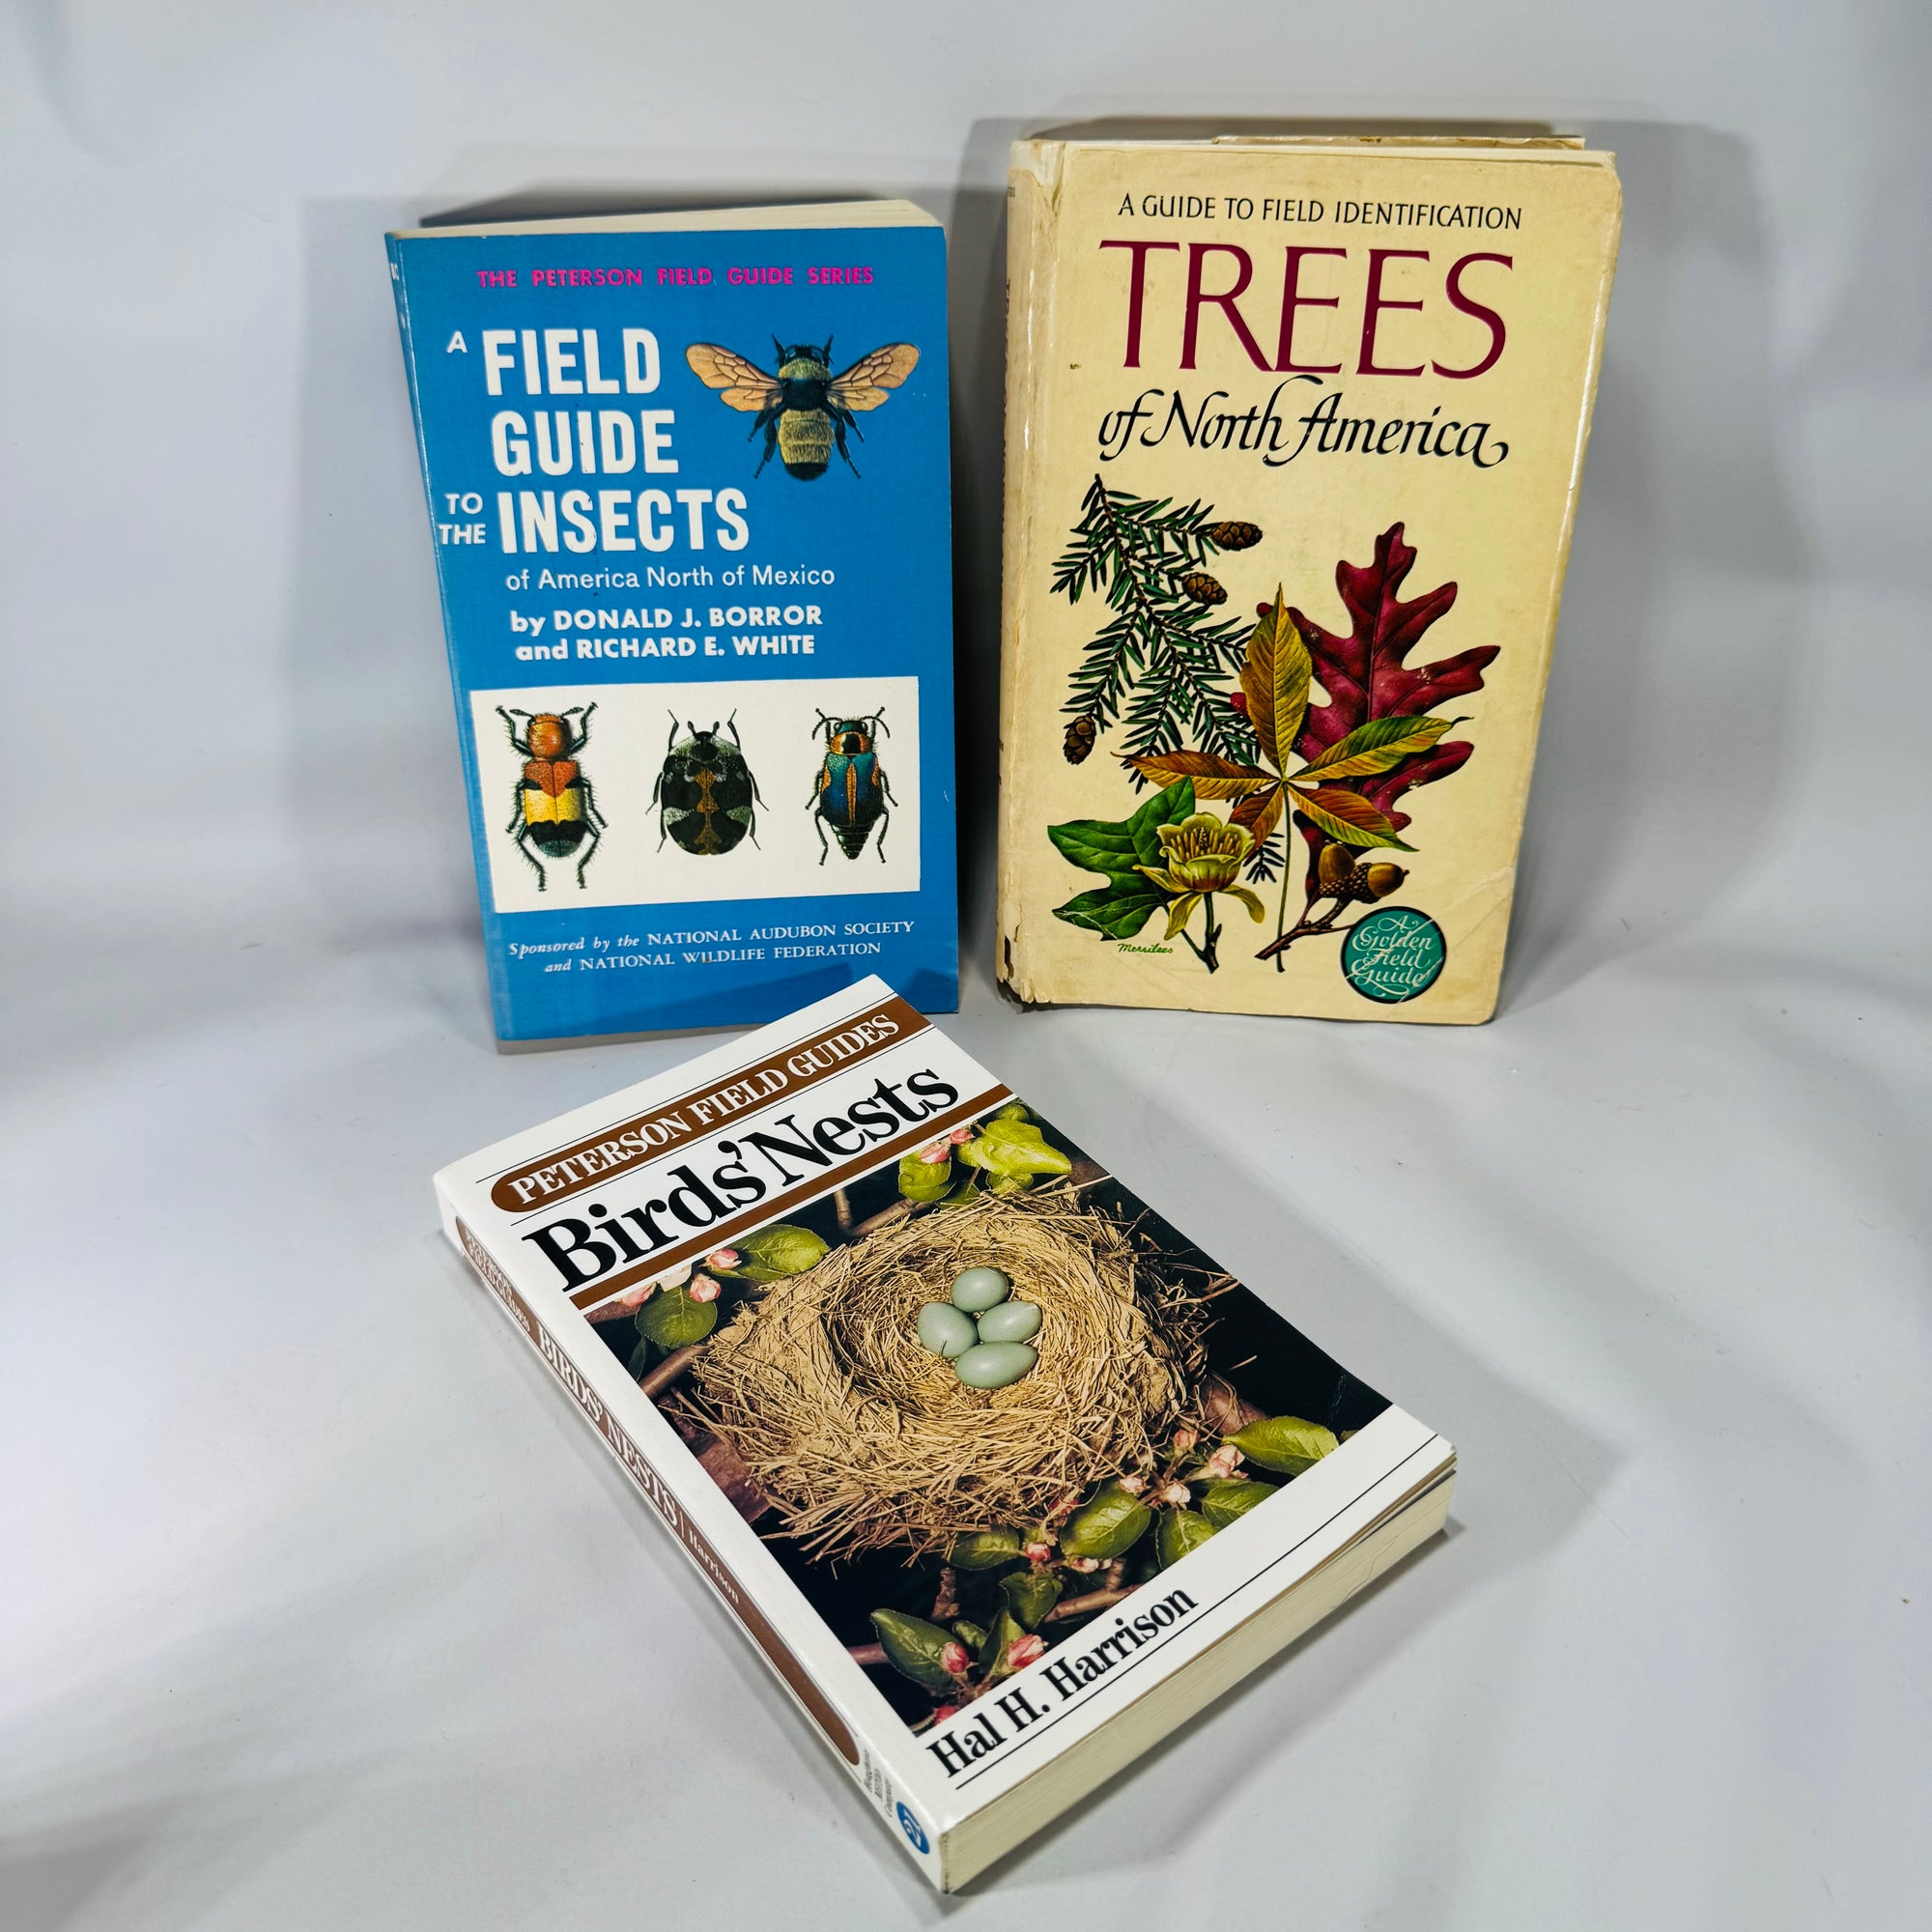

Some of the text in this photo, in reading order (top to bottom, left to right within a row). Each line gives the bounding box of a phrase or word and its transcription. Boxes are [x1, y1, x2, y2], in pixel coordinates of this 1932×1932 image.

[1118, 193, 1522, 231] A GUIDE TO FIELD IDENTIFICATION
[477, 267, 874, 288] THE PETERSON FIELD GUIDE SERIES
[1098, 240, 1514, 381] TREES
[446, 328, 661, 395] A FIELD
[1097, 373, 1510, 469] of North America
[492, 410, 679, 475] GUIDE
[446, 494, 483, 515] TO
[498, 488, 750, 554] INSECTS
[440, 525, 486, 545] THE
[506, 564, 836, 591] of America North of Mexico
[510, 607, 823, 637] by DONALD J. BORROR
[515, 637, 815, 661] and RICHARD E. WHITE
[509, 921, 915, 956] Sponsored by the NATIONAL AUDUBON SOCIETY
[1352, 926, 1435, 951] Golden
[1378, 915, 1418, 931] A
[544, 942, 882, 972] and NATIONAL WILDLIFE FEDERATION
[1363, 948, 1431, 969] Field
[1350, 957, 1429, 997] Guide
[506, 1013, 900, 1205] PETERSON FIELD GUIDES
[522, 1068, 959, 1293] Birds' Nests
[536, 1321, 740, 1605] BIRDS' NESTS Harrison
[925, 1587, 1199, 1777] Hal H. Harrison
